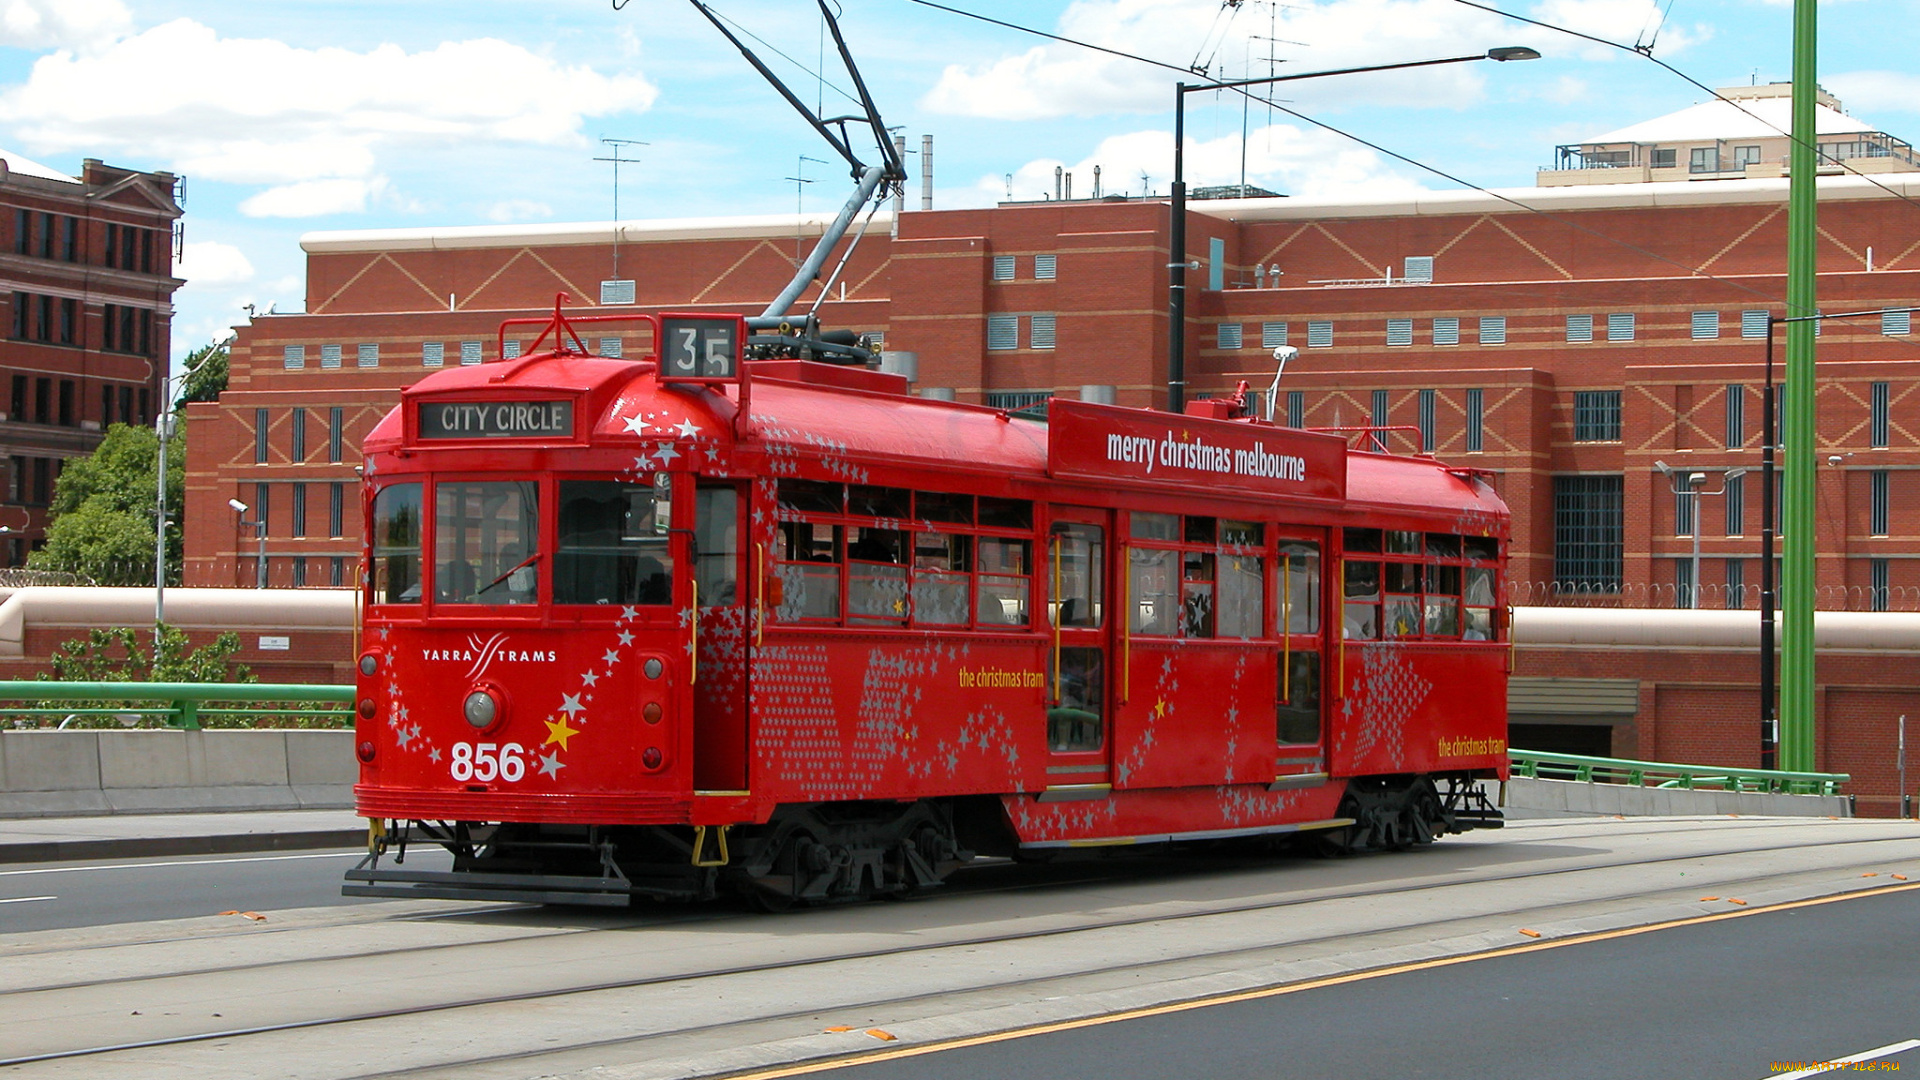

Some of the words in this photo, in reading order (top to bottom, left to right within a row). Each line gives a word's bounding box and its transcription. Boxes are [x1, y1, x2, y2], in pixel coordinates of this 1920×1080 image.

[677, 328, 729, 376] 35
[441, 406, 489, 430] CITY
[496, 406, 563, 430] CIRCLE
[1107, 433, 1155, 474] merry
[1160, 429, 1231, 473] christmas
[1235, 441, 1305, 481] melbourne
[423, 650, 472, 660] YARRA
[498, 651, 556, 661] TRAMS
[959, 666, 974, 687] the
[976, 666, 1021, 687] christmas
[1023, 669, 1044, 687] tram
[1438, 736, 1451, 757] the
[1453, 736, 1487, 756] christmas
[1488, 736, 1505, 754] tram
[450, 742, 525, 782] 856
